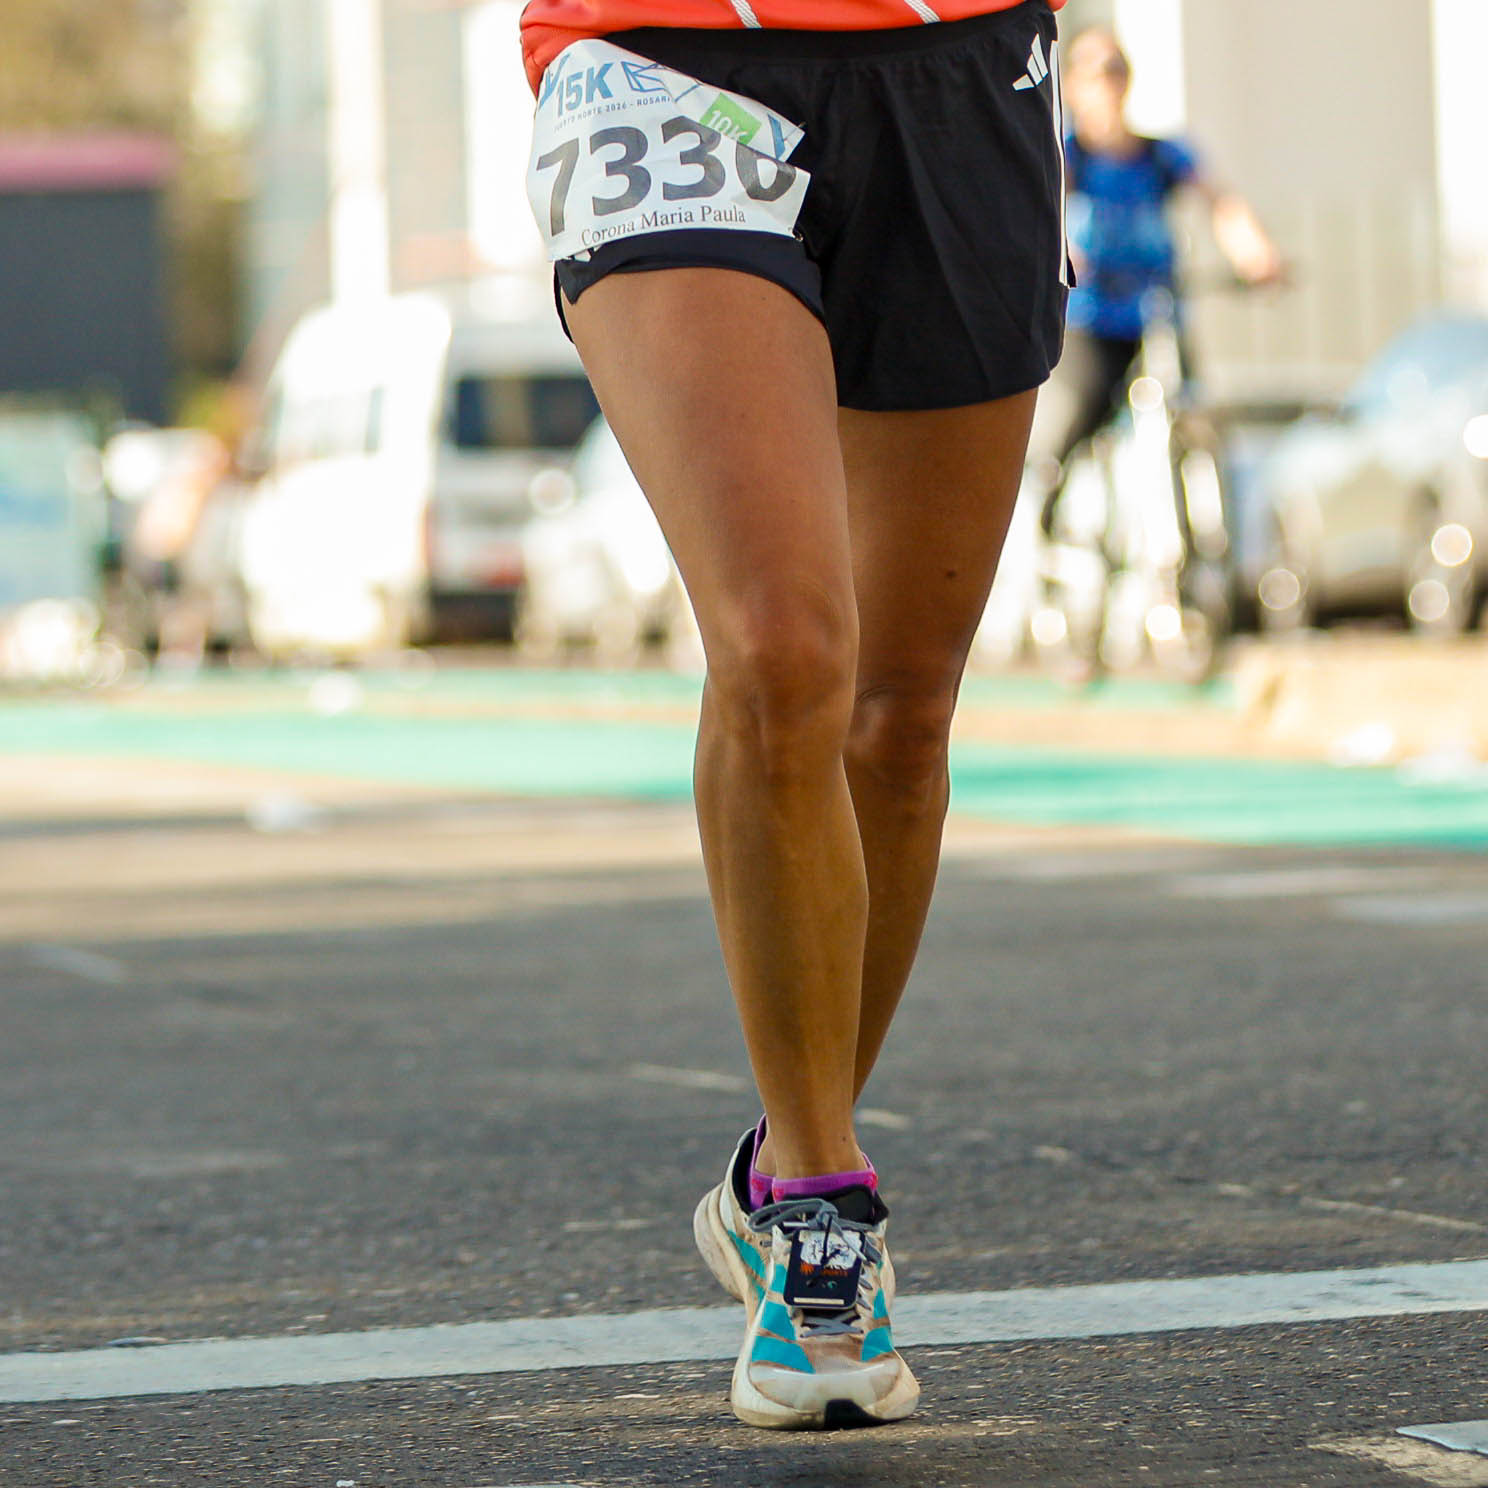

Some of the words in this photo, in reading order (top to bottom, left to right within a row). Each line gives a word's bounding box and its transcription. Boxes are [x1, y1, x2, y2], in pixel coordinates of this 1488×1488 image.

[557, 62, 614, 118] 15K
[581, 221, 635, 247] Corona
[641, 207, 694, 229] Maria
[700, 205, 746, 223] Paula
